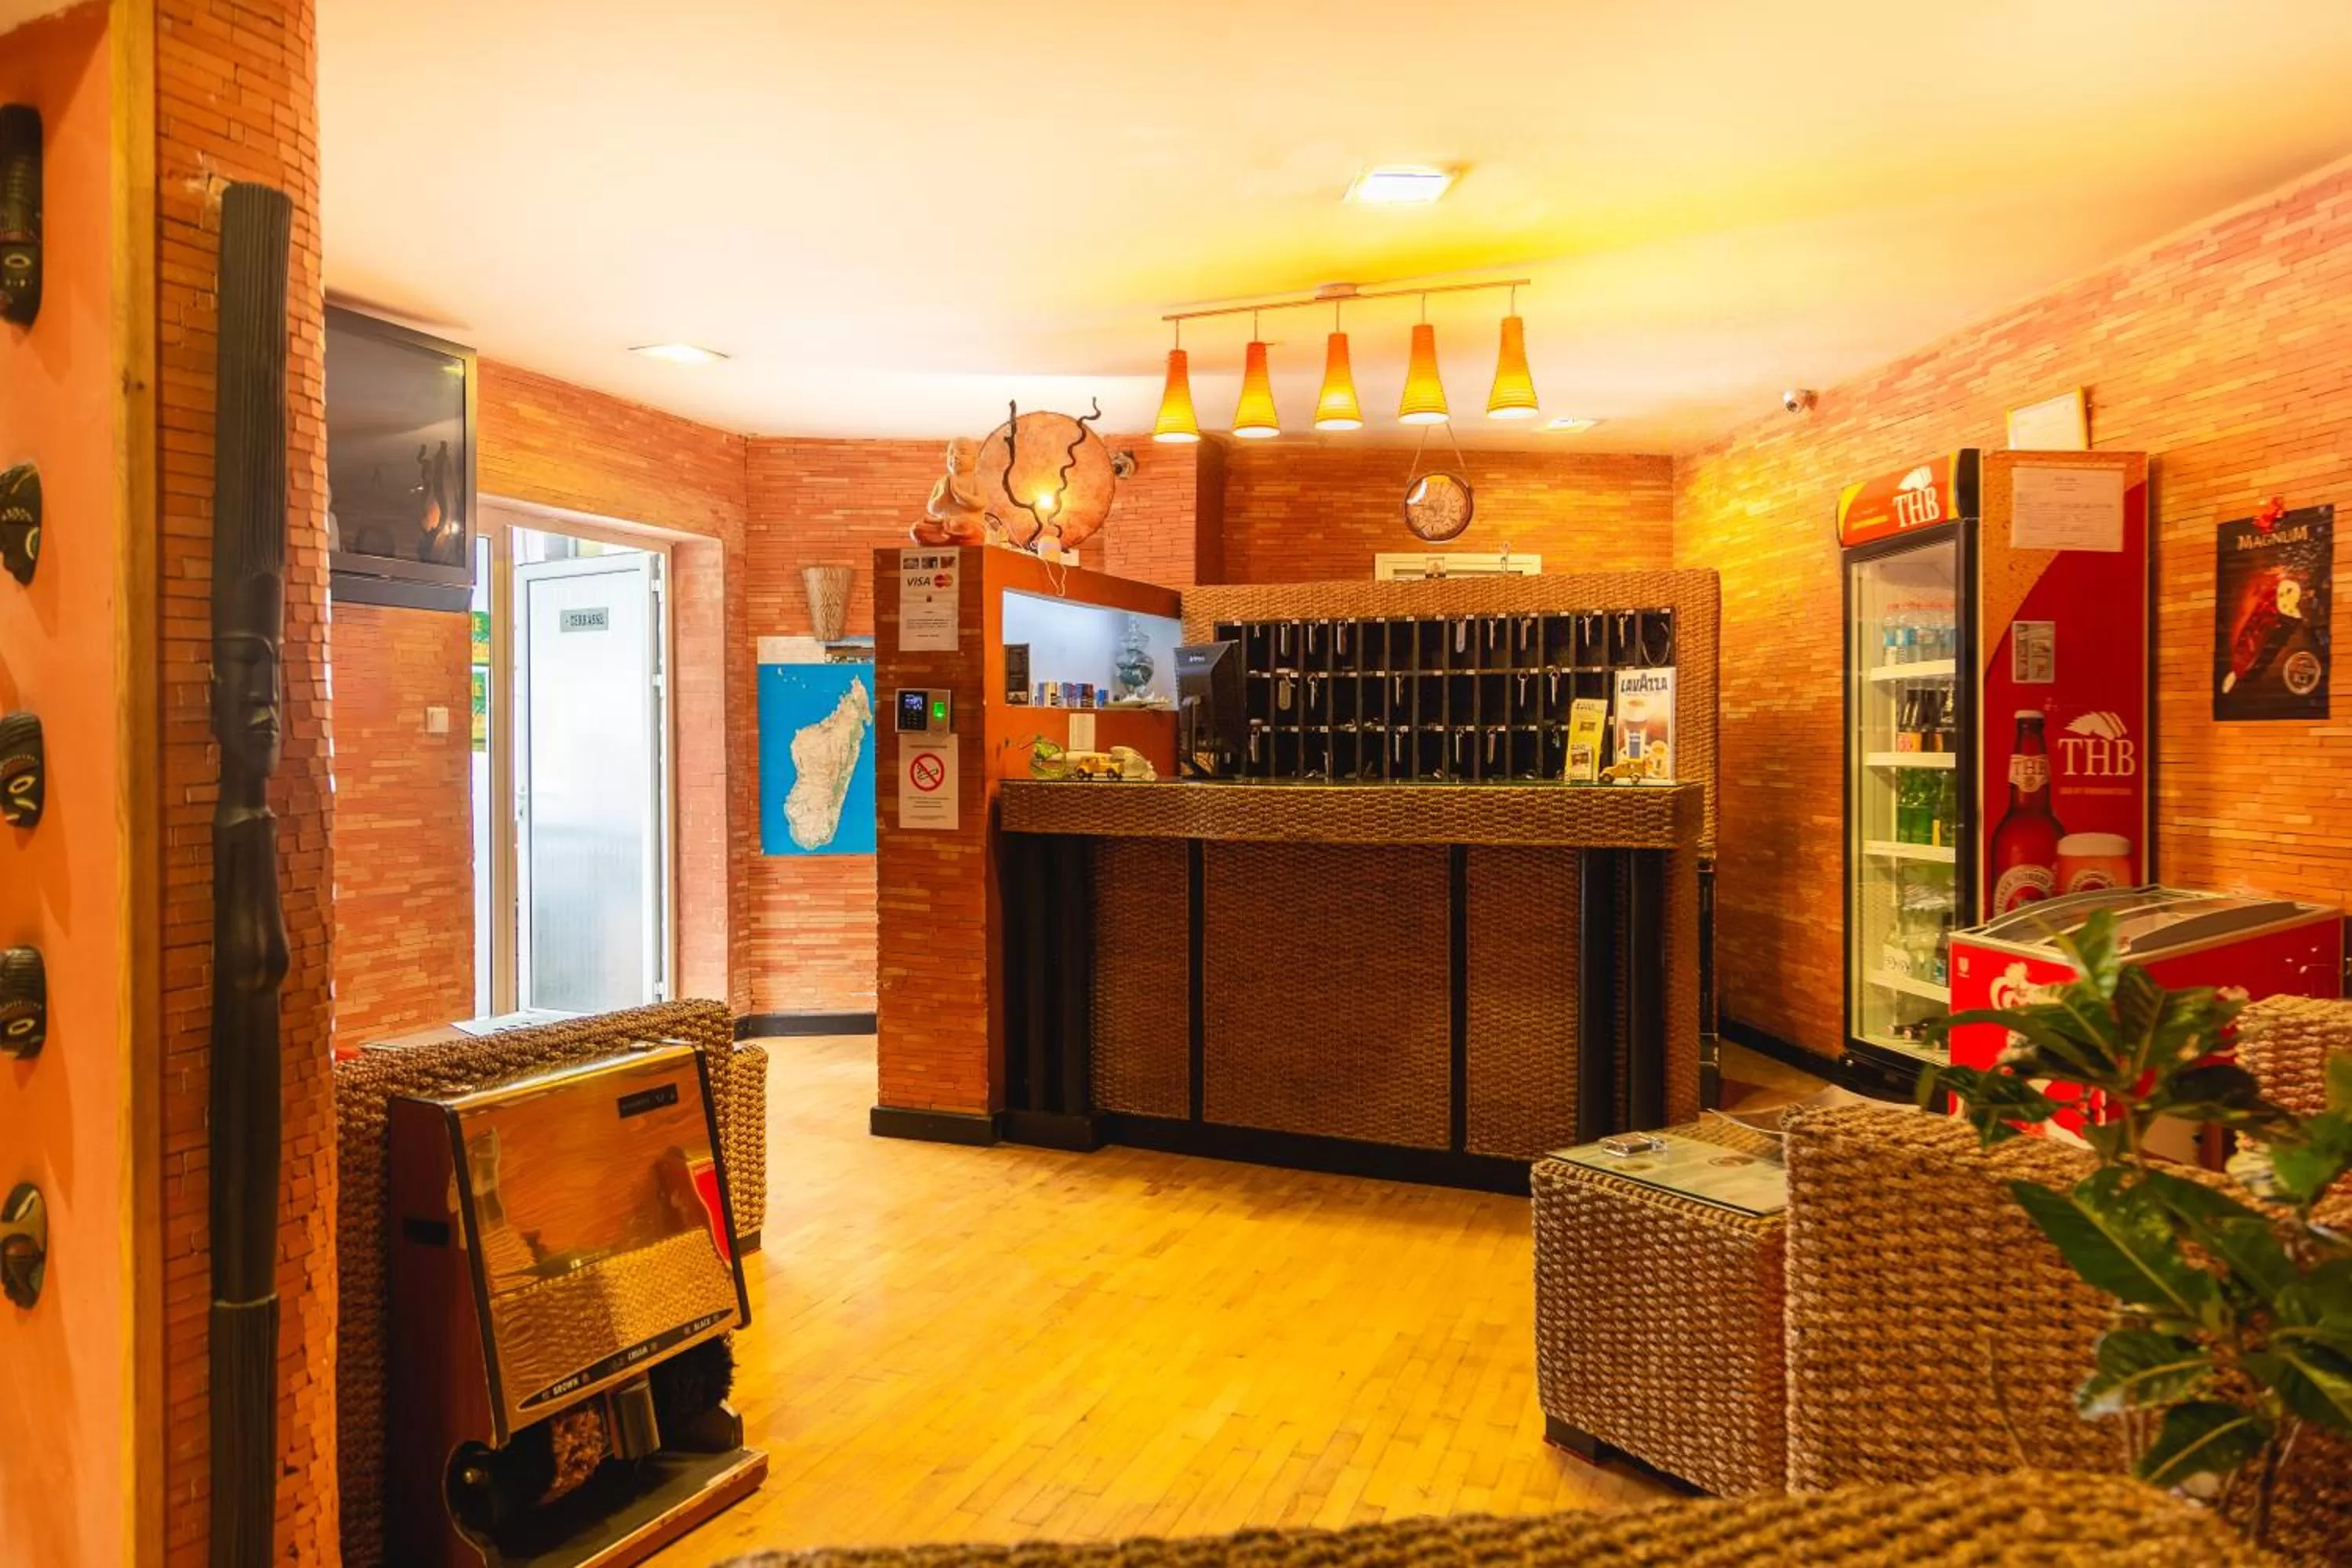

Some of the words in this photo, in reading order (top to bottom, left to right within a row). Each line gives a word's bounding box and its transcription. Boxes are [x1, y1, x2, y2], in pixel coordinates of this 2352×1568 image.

[1893, 486, 1940, 528] THB
[2237, 524, 2309, 550] MAGNUM
[906, 576, 931, 587] VISA
[1621, 673, 1668, 692] LAVAZZA
[2057, 738, 2136, 776] THB
[553, 1377, 579, 1396] BROWN
